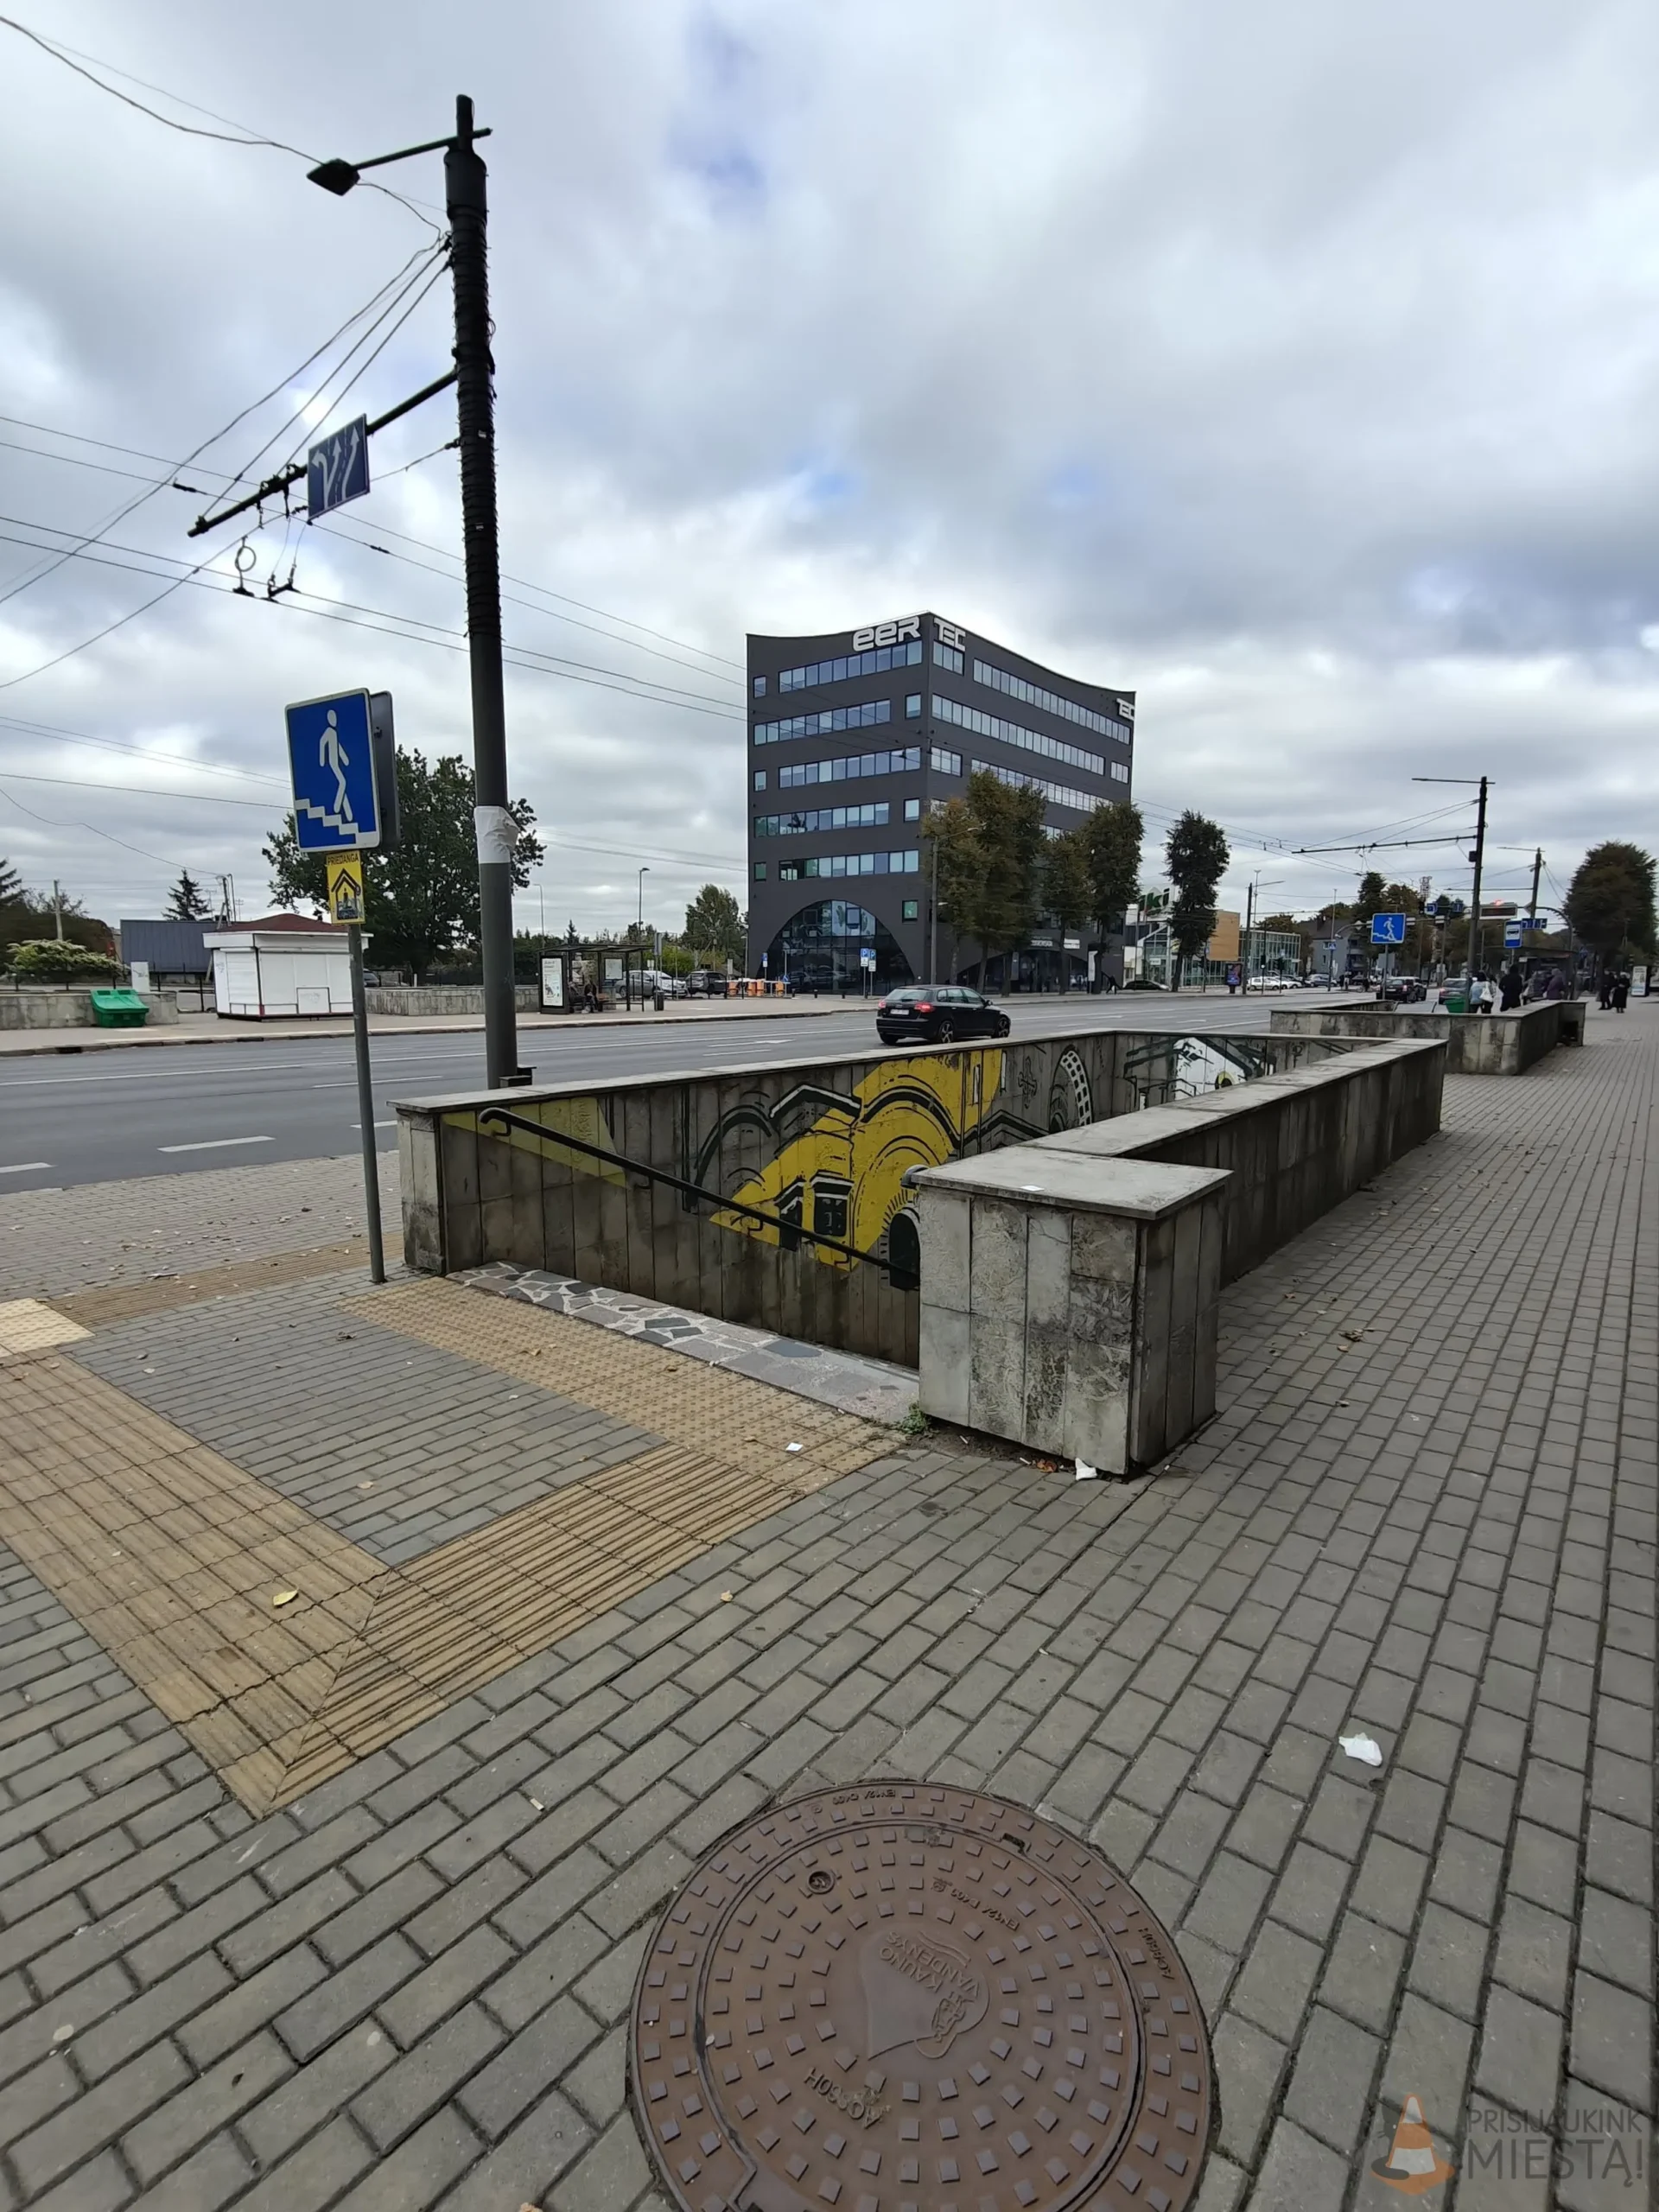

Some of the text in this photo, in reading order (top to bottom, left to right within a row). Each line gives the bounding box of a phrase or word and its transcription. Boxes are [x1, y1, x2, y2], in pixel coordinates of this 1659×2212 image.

[934, 617, 966, 652] TEC
[327, 853, 359, 866] PRIEDANGA
[880, 1948, 944, 1994] KAUNO
[887, 1931, 981, 1999] VANDENYS
